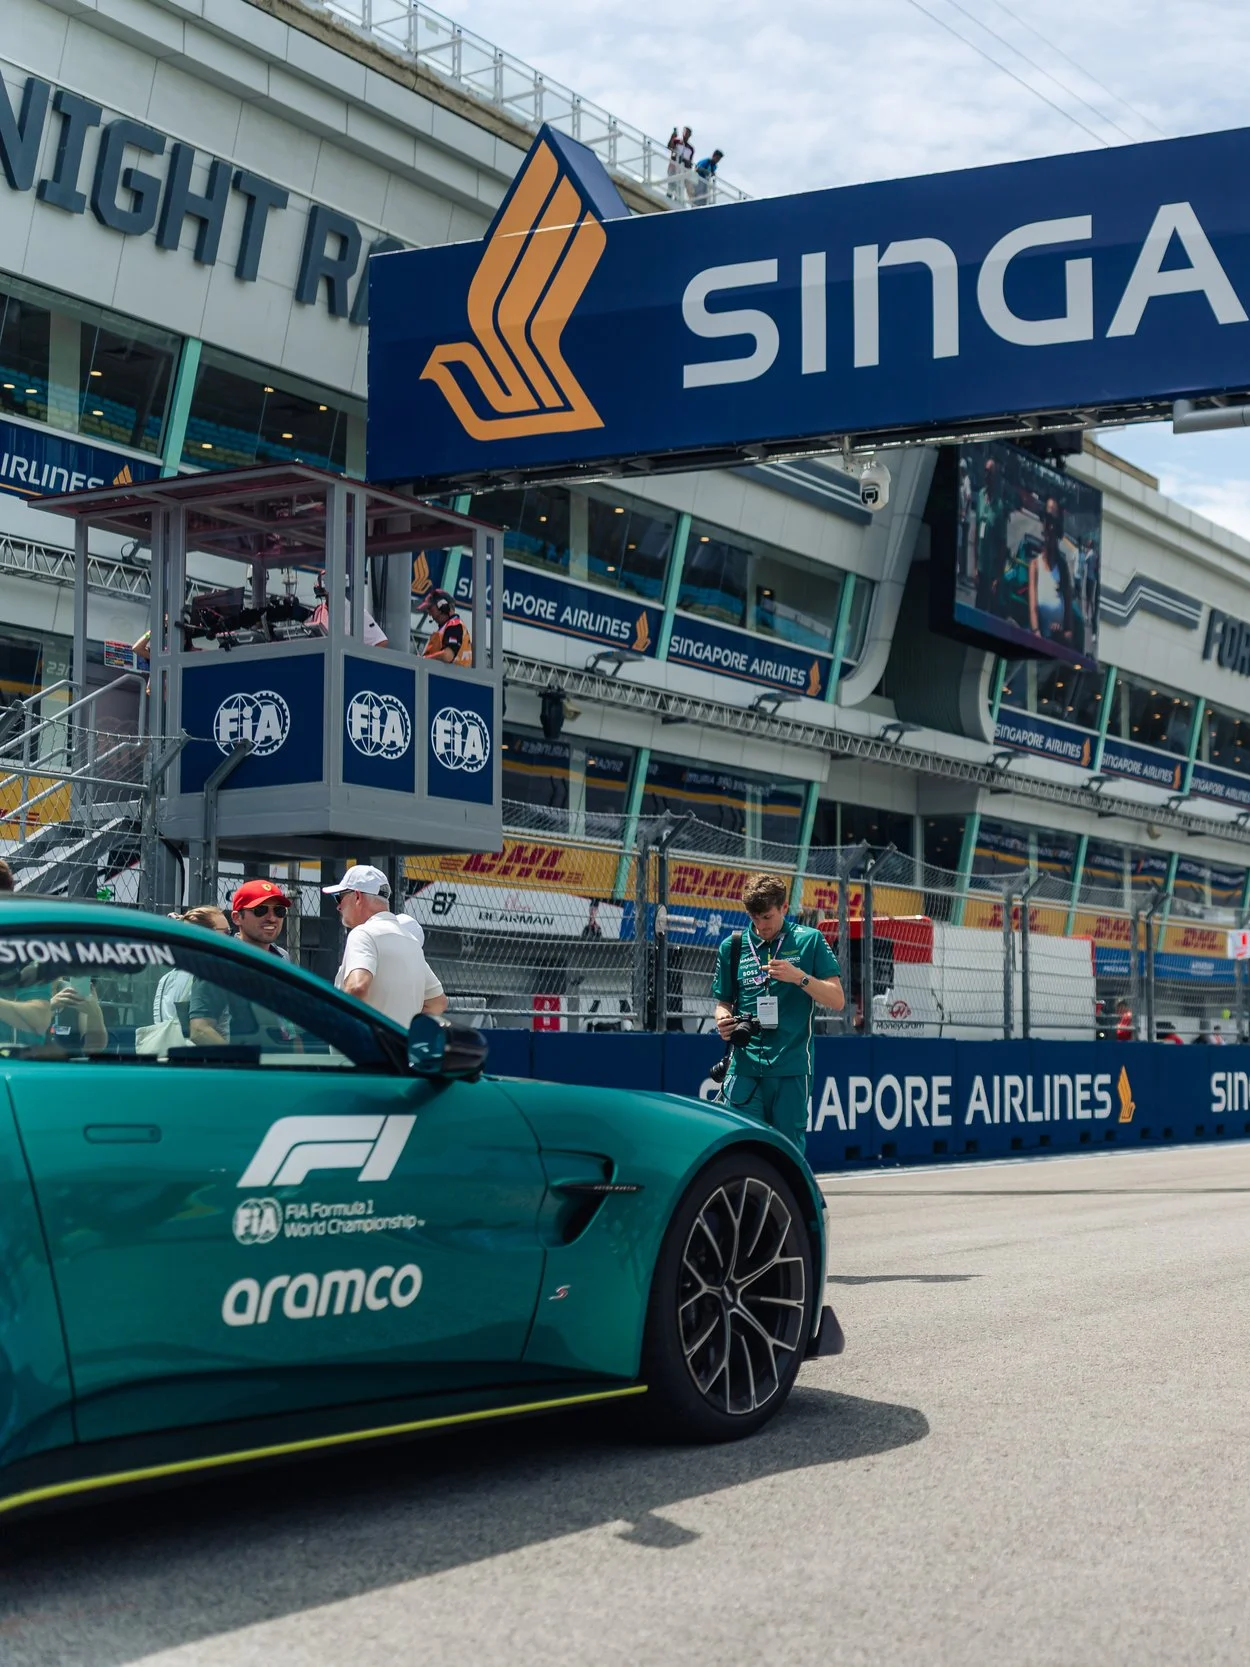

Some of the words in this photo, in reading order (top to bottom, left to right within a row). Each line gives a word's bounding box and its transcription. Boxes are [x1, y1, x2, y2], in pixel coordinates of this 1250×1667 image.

[0, 70, 289, 282] NIGHT
[560, 605, 632, 640] AIRLINES
[670, 635, 748, 671] SINGAPORE
[750, 657, 806, 686] AIRLINES
[994, 724, 1043, 749] SINGAPORE
[1045, 735, 1081, 758] AIRLINES
[1100, 752, 1142, 775] SINGAPORE
[1143, 765, 1172, 783] AIRLINES
[463, 845, 566, 882] DHL
[431, 890, 457, 916] 87
[478, 910, 555, 926] BEARMAN
[0, 940, 72, 963] STON
[76, 942, 175, 965] MARTIN
[876, 1021, 925, 1031] MoneyGram
[965, 1073, 1112, 1126] AIRLINES
[285, 1204, 309, 1220] FIA
[310, 1201, 365, 1218] Formula
[366, 1200, 374, 1214] 1
[284, 1219, 326, 1238] World
[222, 1263, 423, 1327] aramco
